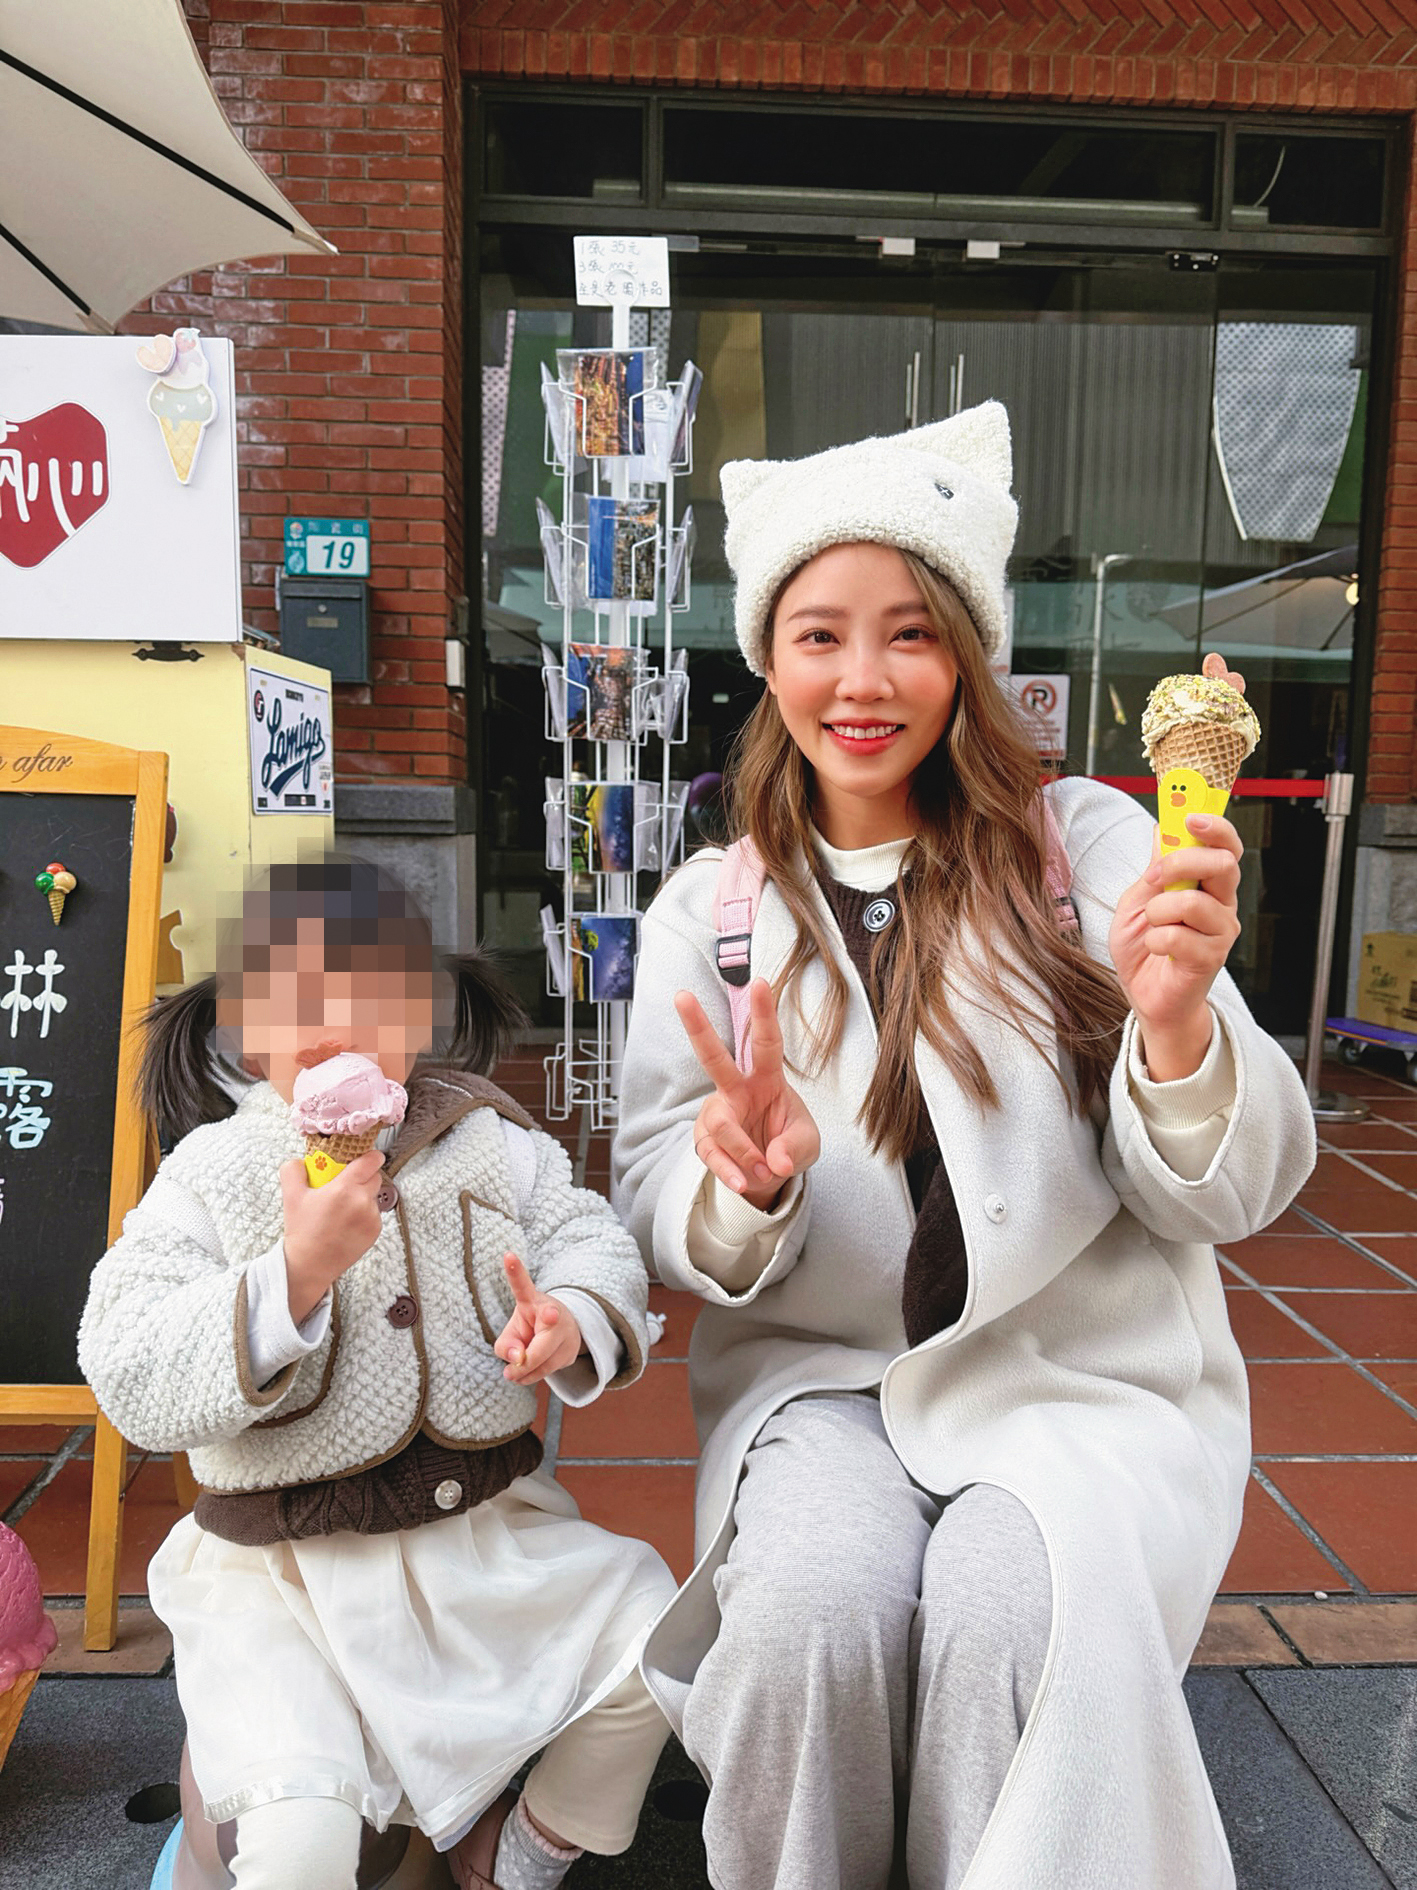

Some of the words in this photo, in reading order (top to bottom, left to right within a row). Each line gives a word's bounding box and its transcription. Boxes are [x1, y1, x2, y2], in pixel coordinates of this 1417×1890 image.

[322, 541, 355, 569] 19
[11, 743, 73, 783] afar
[261, 697, 326, 795] Lamigo
